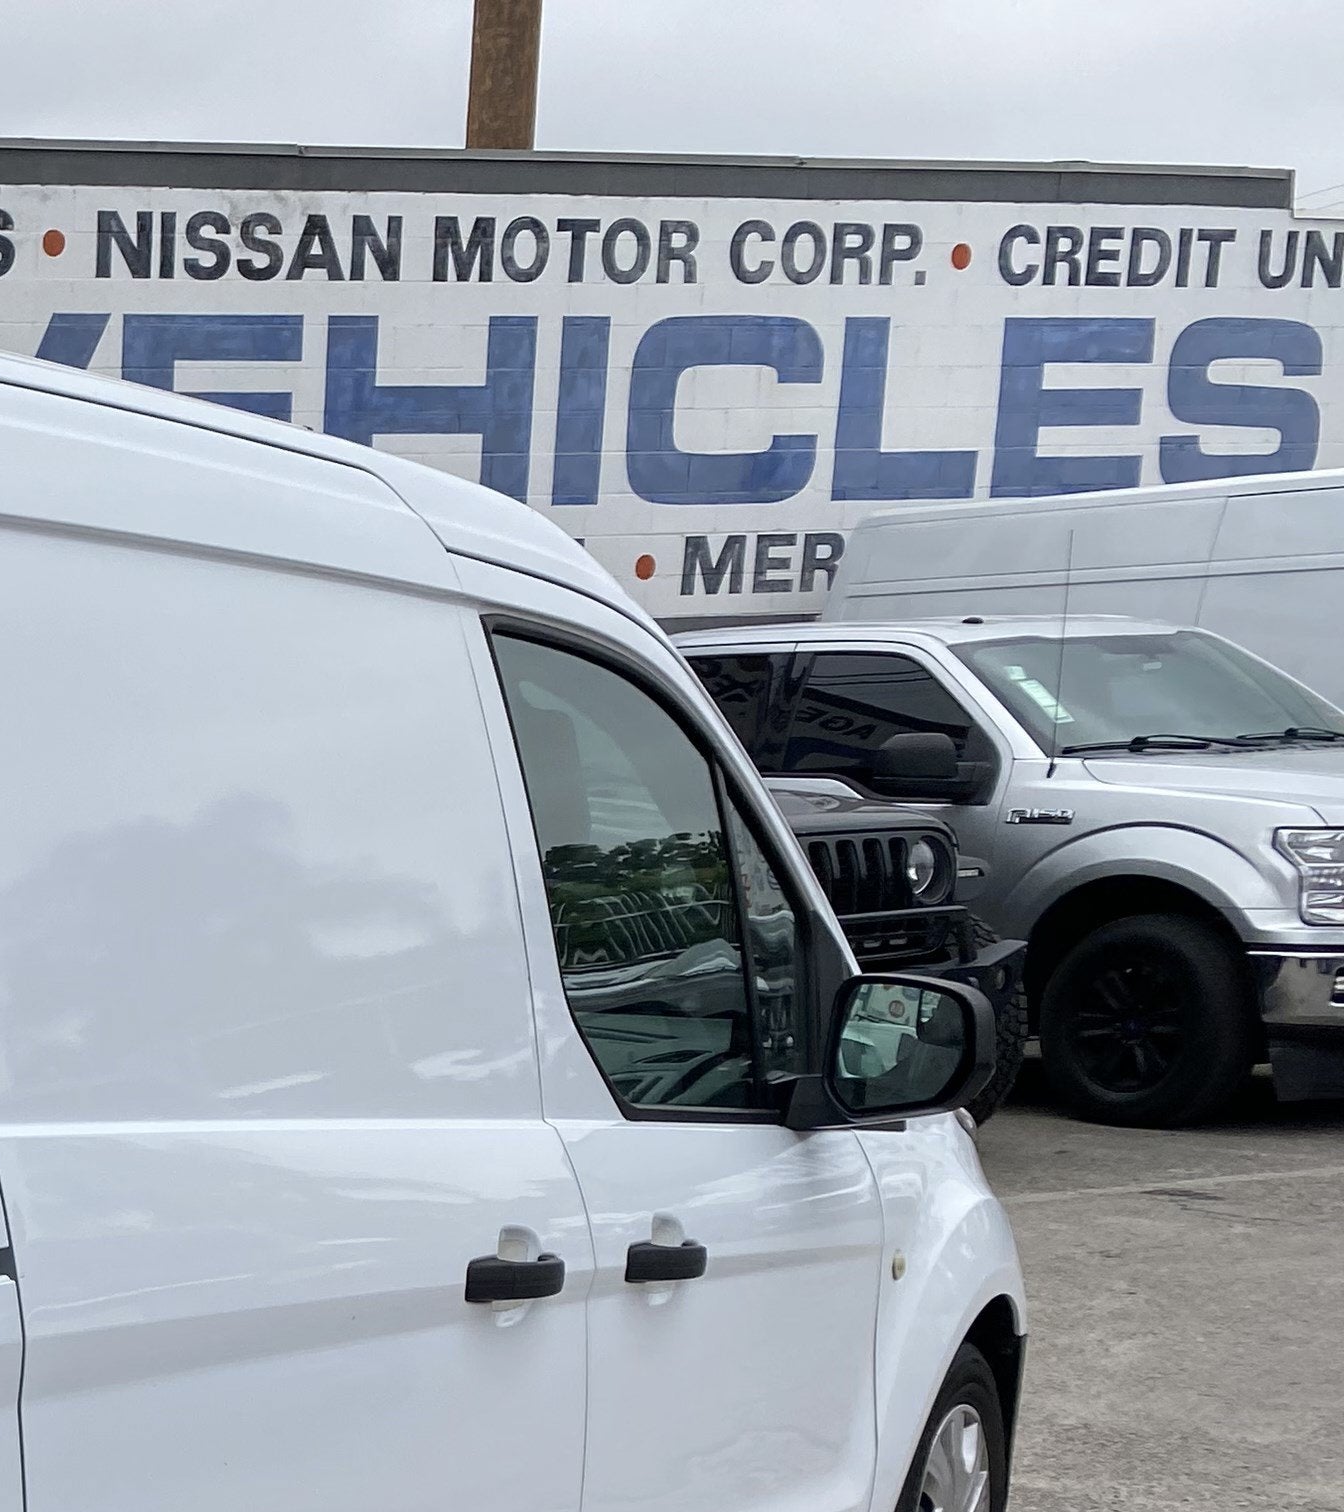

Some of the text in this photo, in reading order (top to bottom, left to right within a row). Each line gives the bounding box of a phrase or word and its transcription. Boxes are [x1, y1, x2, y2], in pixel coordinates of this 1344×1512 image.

[95, 209, 404, 283] NISSAN
[432, 215, 701, 286] MOTOR
[729, 219, 926, 287] CORP.
[997, 224, 1237, 288] CREDIT
[1258, 229, 1344, 289] UN
[679, 533, 846, 596] MER
